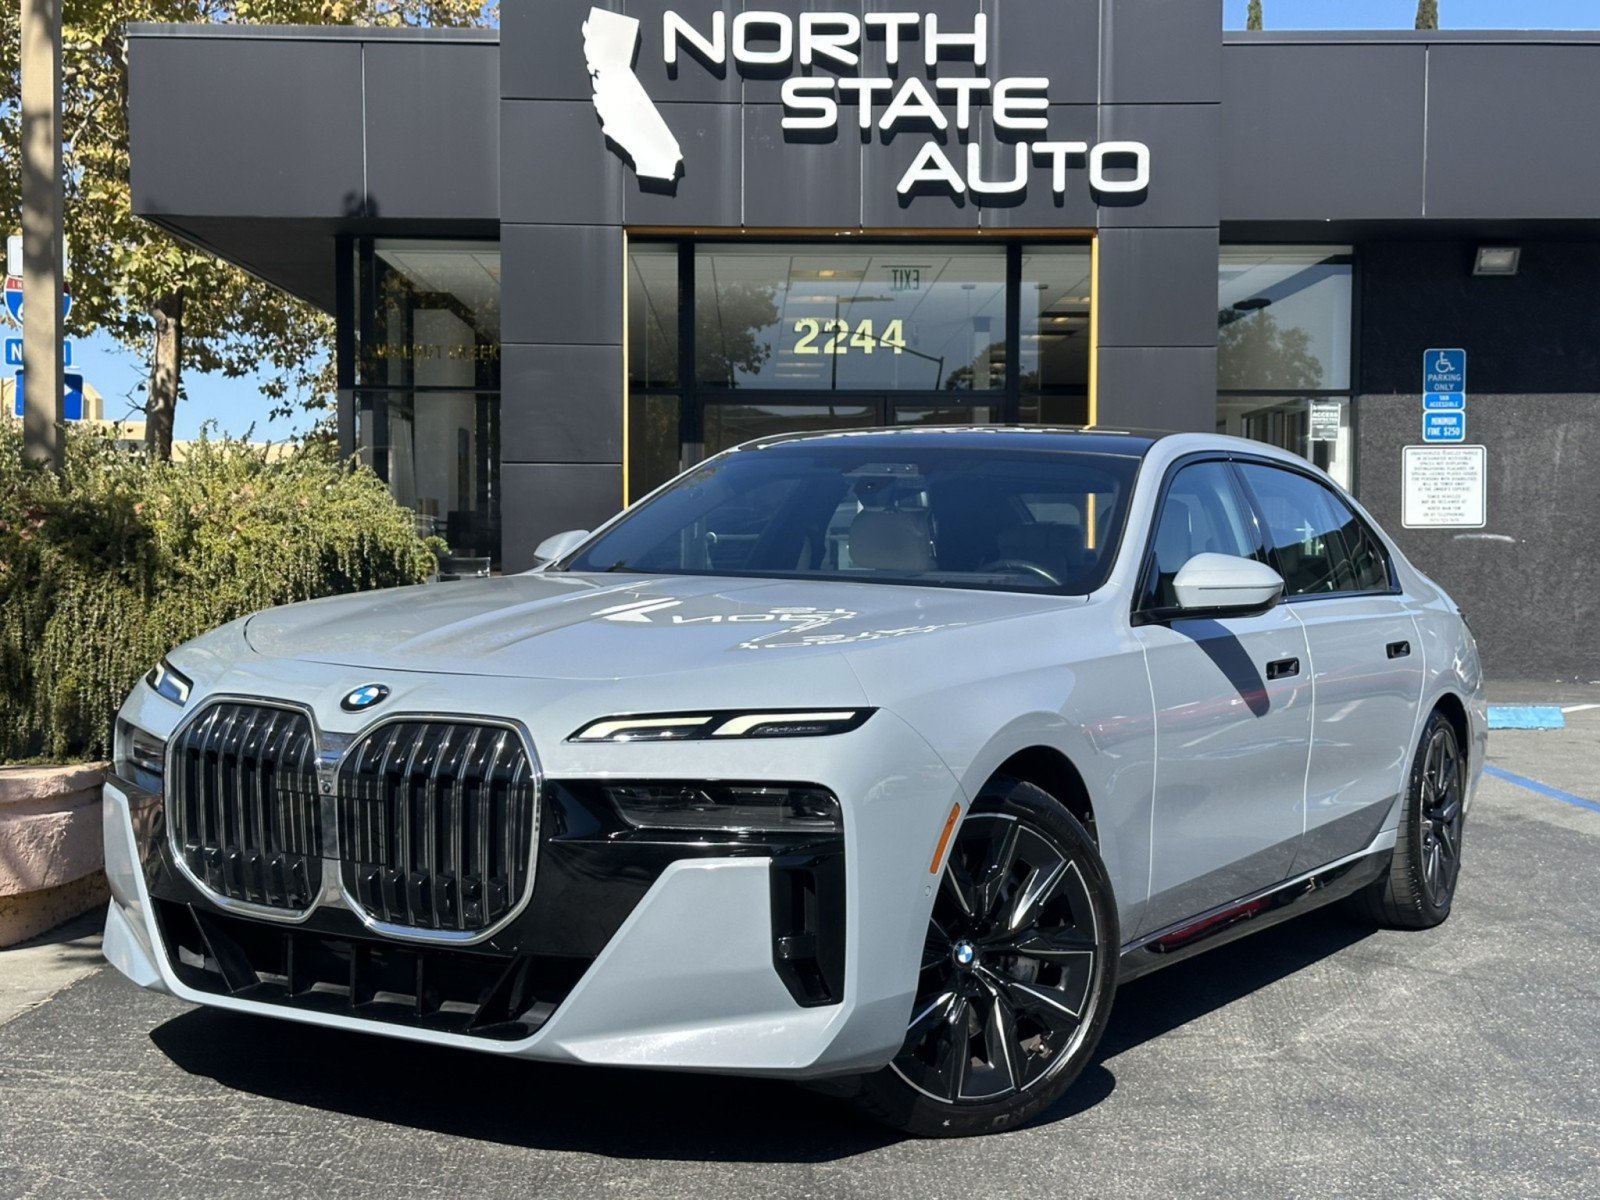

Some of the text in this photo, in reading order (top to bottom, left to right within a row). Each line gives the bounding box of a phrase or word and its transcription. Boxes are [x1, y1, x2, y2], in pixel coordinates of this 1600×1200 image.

[664, 11, 987, 66] NORTH
[781, 77, 1050, 130] STATE
[896, 141, 1150, 194] AUTO
[793, 318, 906, 354] 2244
[1427, 373, 1461, 381] PARKING
[1427, 426, 1461, 436] FINE $250
